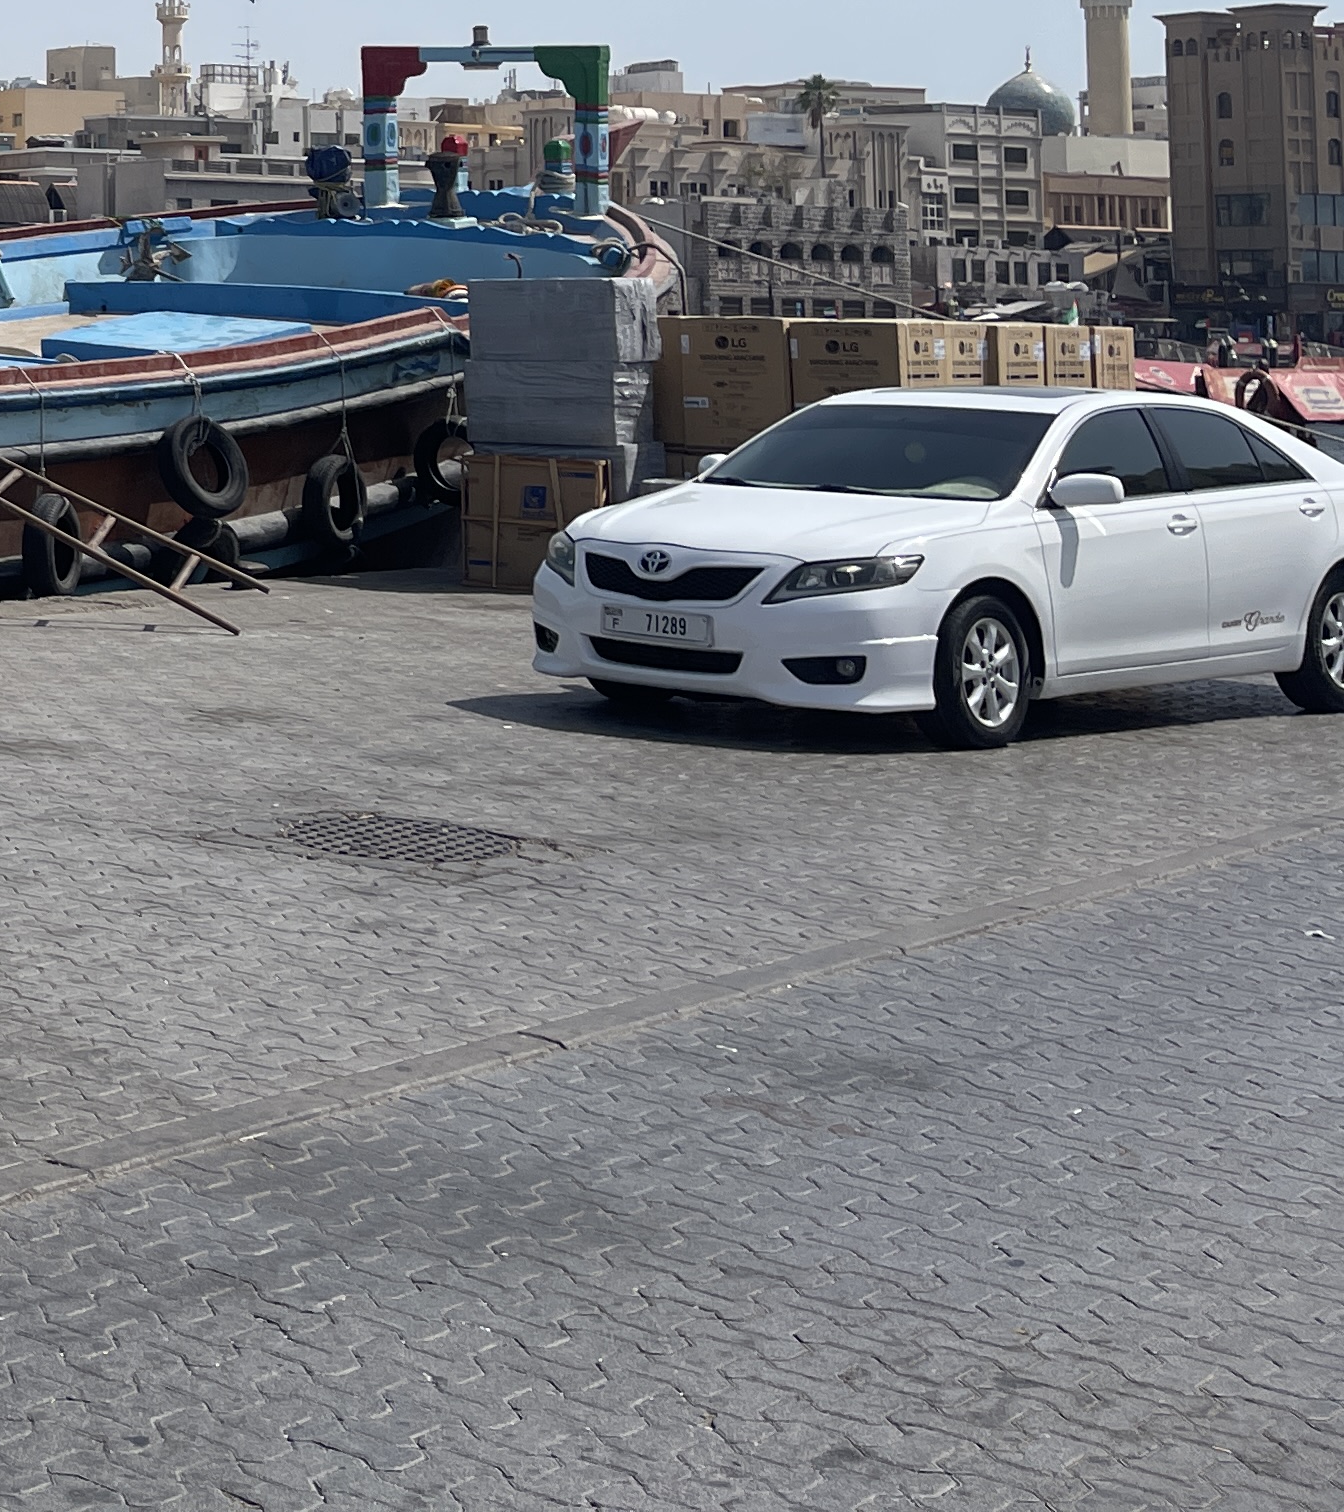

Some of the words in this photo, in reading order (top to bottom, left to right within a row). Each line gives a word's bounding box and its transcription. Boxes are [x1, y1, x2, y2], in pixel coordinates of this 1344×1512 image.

[731, 338, 747, 348] LG
[842, 342, 859, 352] LG
[612, 617, 620, 629] F
[645, 613, 687, 636] 71289
